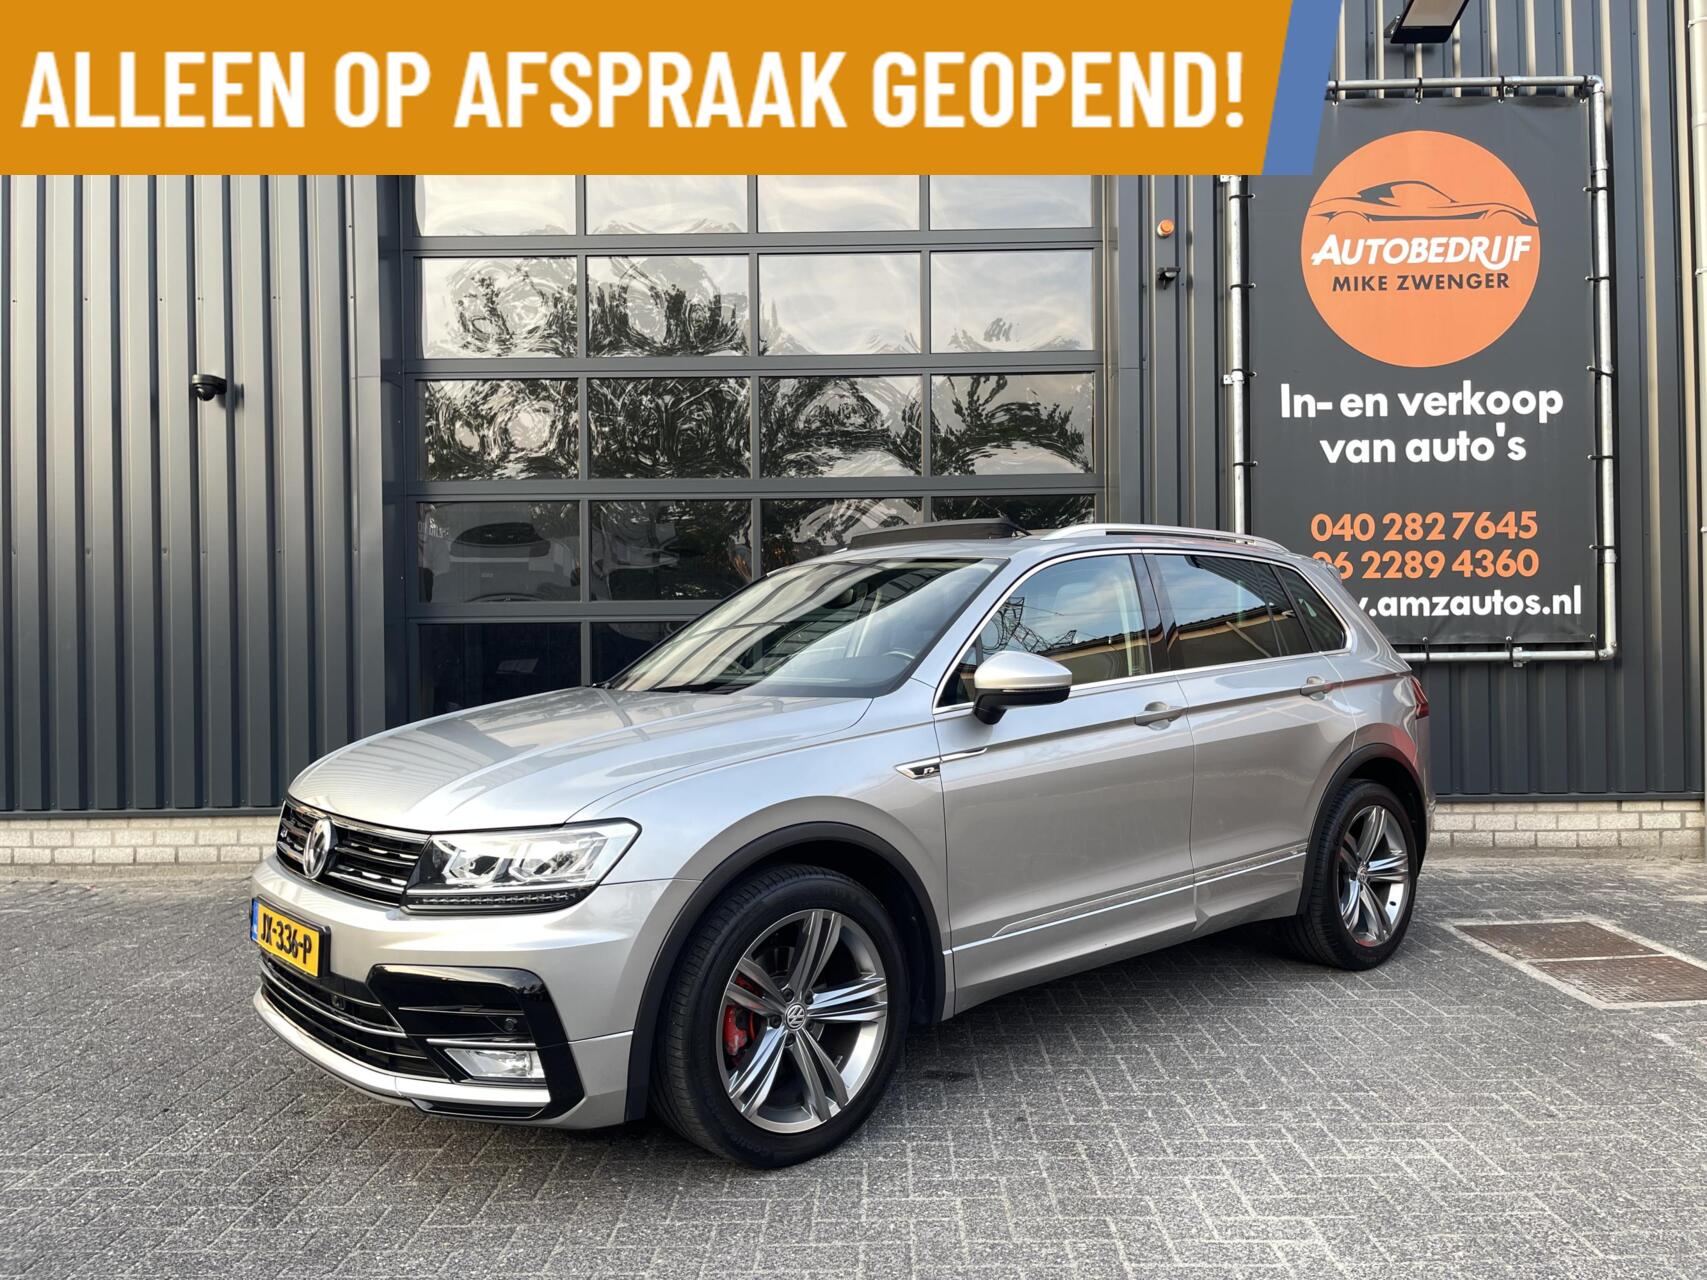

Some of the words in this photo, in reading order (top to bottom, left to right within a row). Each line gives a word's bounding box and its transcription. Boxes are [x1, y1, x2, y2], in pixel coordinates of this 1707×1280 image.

[1311, 234, 1532, 271] AUTOBEDRIJF
[1332, 275, 1388, 292] MIKE
[1396, 272, 1510, 291] ZWENGER
[1280, 383, 1333, 418] In-
[1340, 393, 1388, 418] en
[1397, 379, 1564, 424] verkoop
[1319, 438, 1396, 464] van
[1405, 421, 1527, 463] auto's
[1311, 513, 1376, 542] 040
[1382, 512, 1445, 541] 282
[1452, 511, 1538, 541] 7645
[1360, 549, 1445, 579] 2289
[1452, 548, 1540, 578] 4360
[261, 913, 312, 965] JX-336-P
